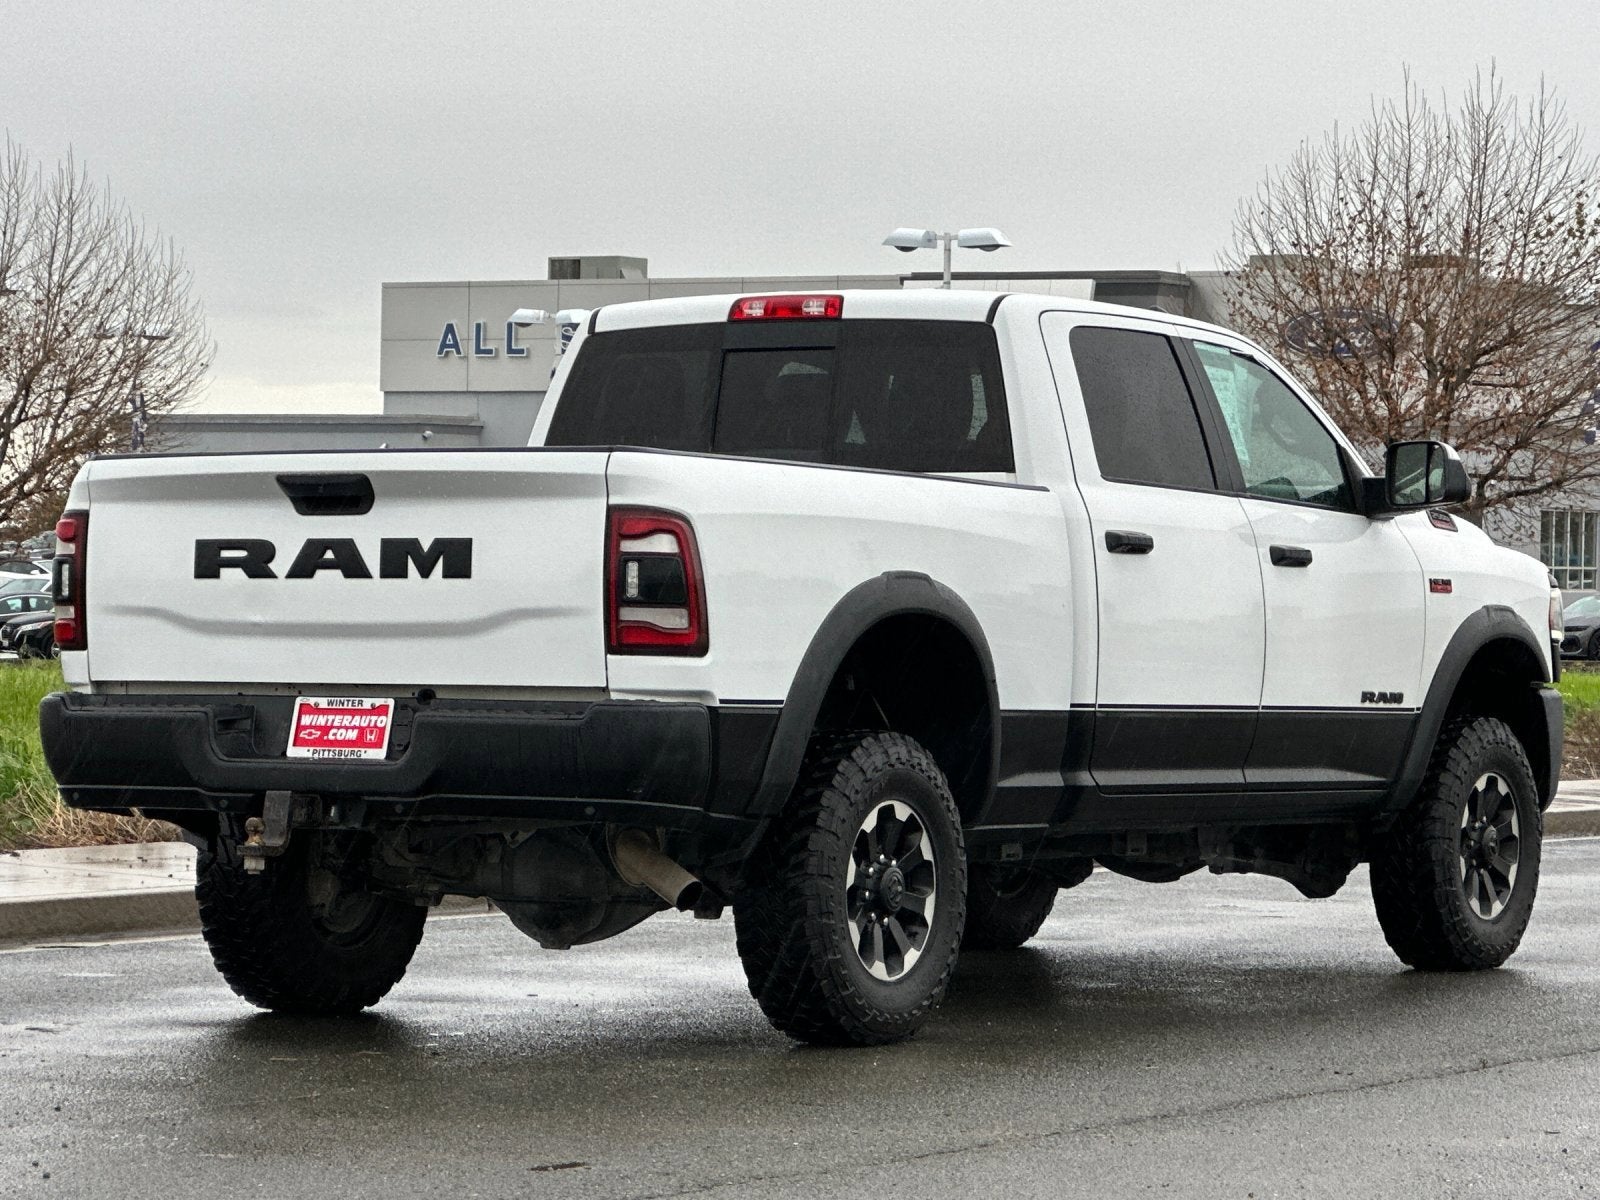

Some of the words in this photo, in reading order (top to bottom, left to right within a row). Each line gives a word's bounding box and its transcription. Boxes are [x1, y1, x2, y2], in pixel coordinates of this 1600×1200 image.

[436, 320, 528, 357] ALL
[194, 537, 473, 579] RAM
[326, 698, 364, 708] WINTER
[1361, 691, 1404, 704] RAM
[300, 714, 387, 727] WINTERAUTO
[323, 728, 359, 740] .COM
[311, 749, 362, 758] PITTSBURG
